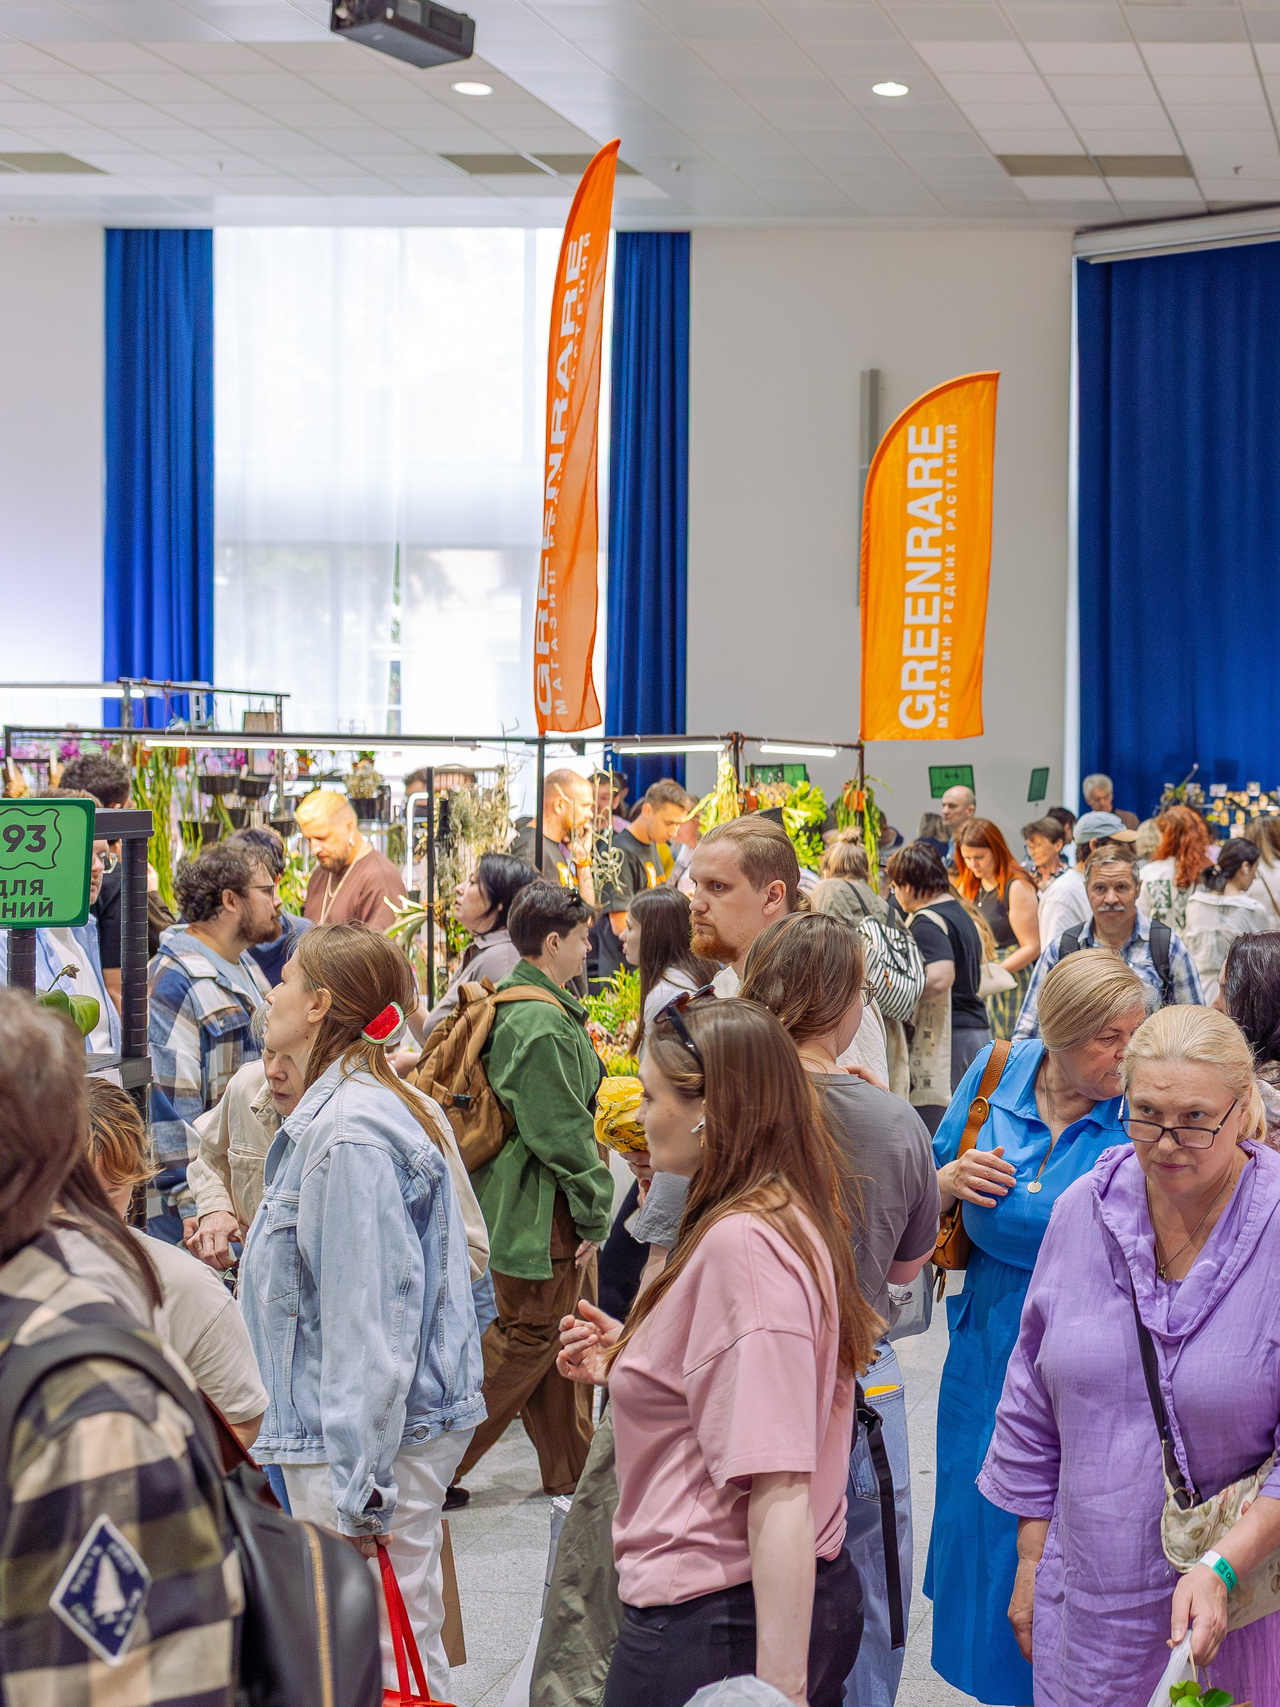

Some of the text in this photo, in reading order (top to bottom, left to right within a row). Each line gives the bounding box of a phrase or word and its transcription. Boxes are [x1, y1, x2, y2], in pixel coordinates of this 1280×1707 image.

[898, 424, 944, 730] GREENRARE
[937, 424, 958, 728] МАГАЗИН РЕДКИХ РАСТЕНИЙ
